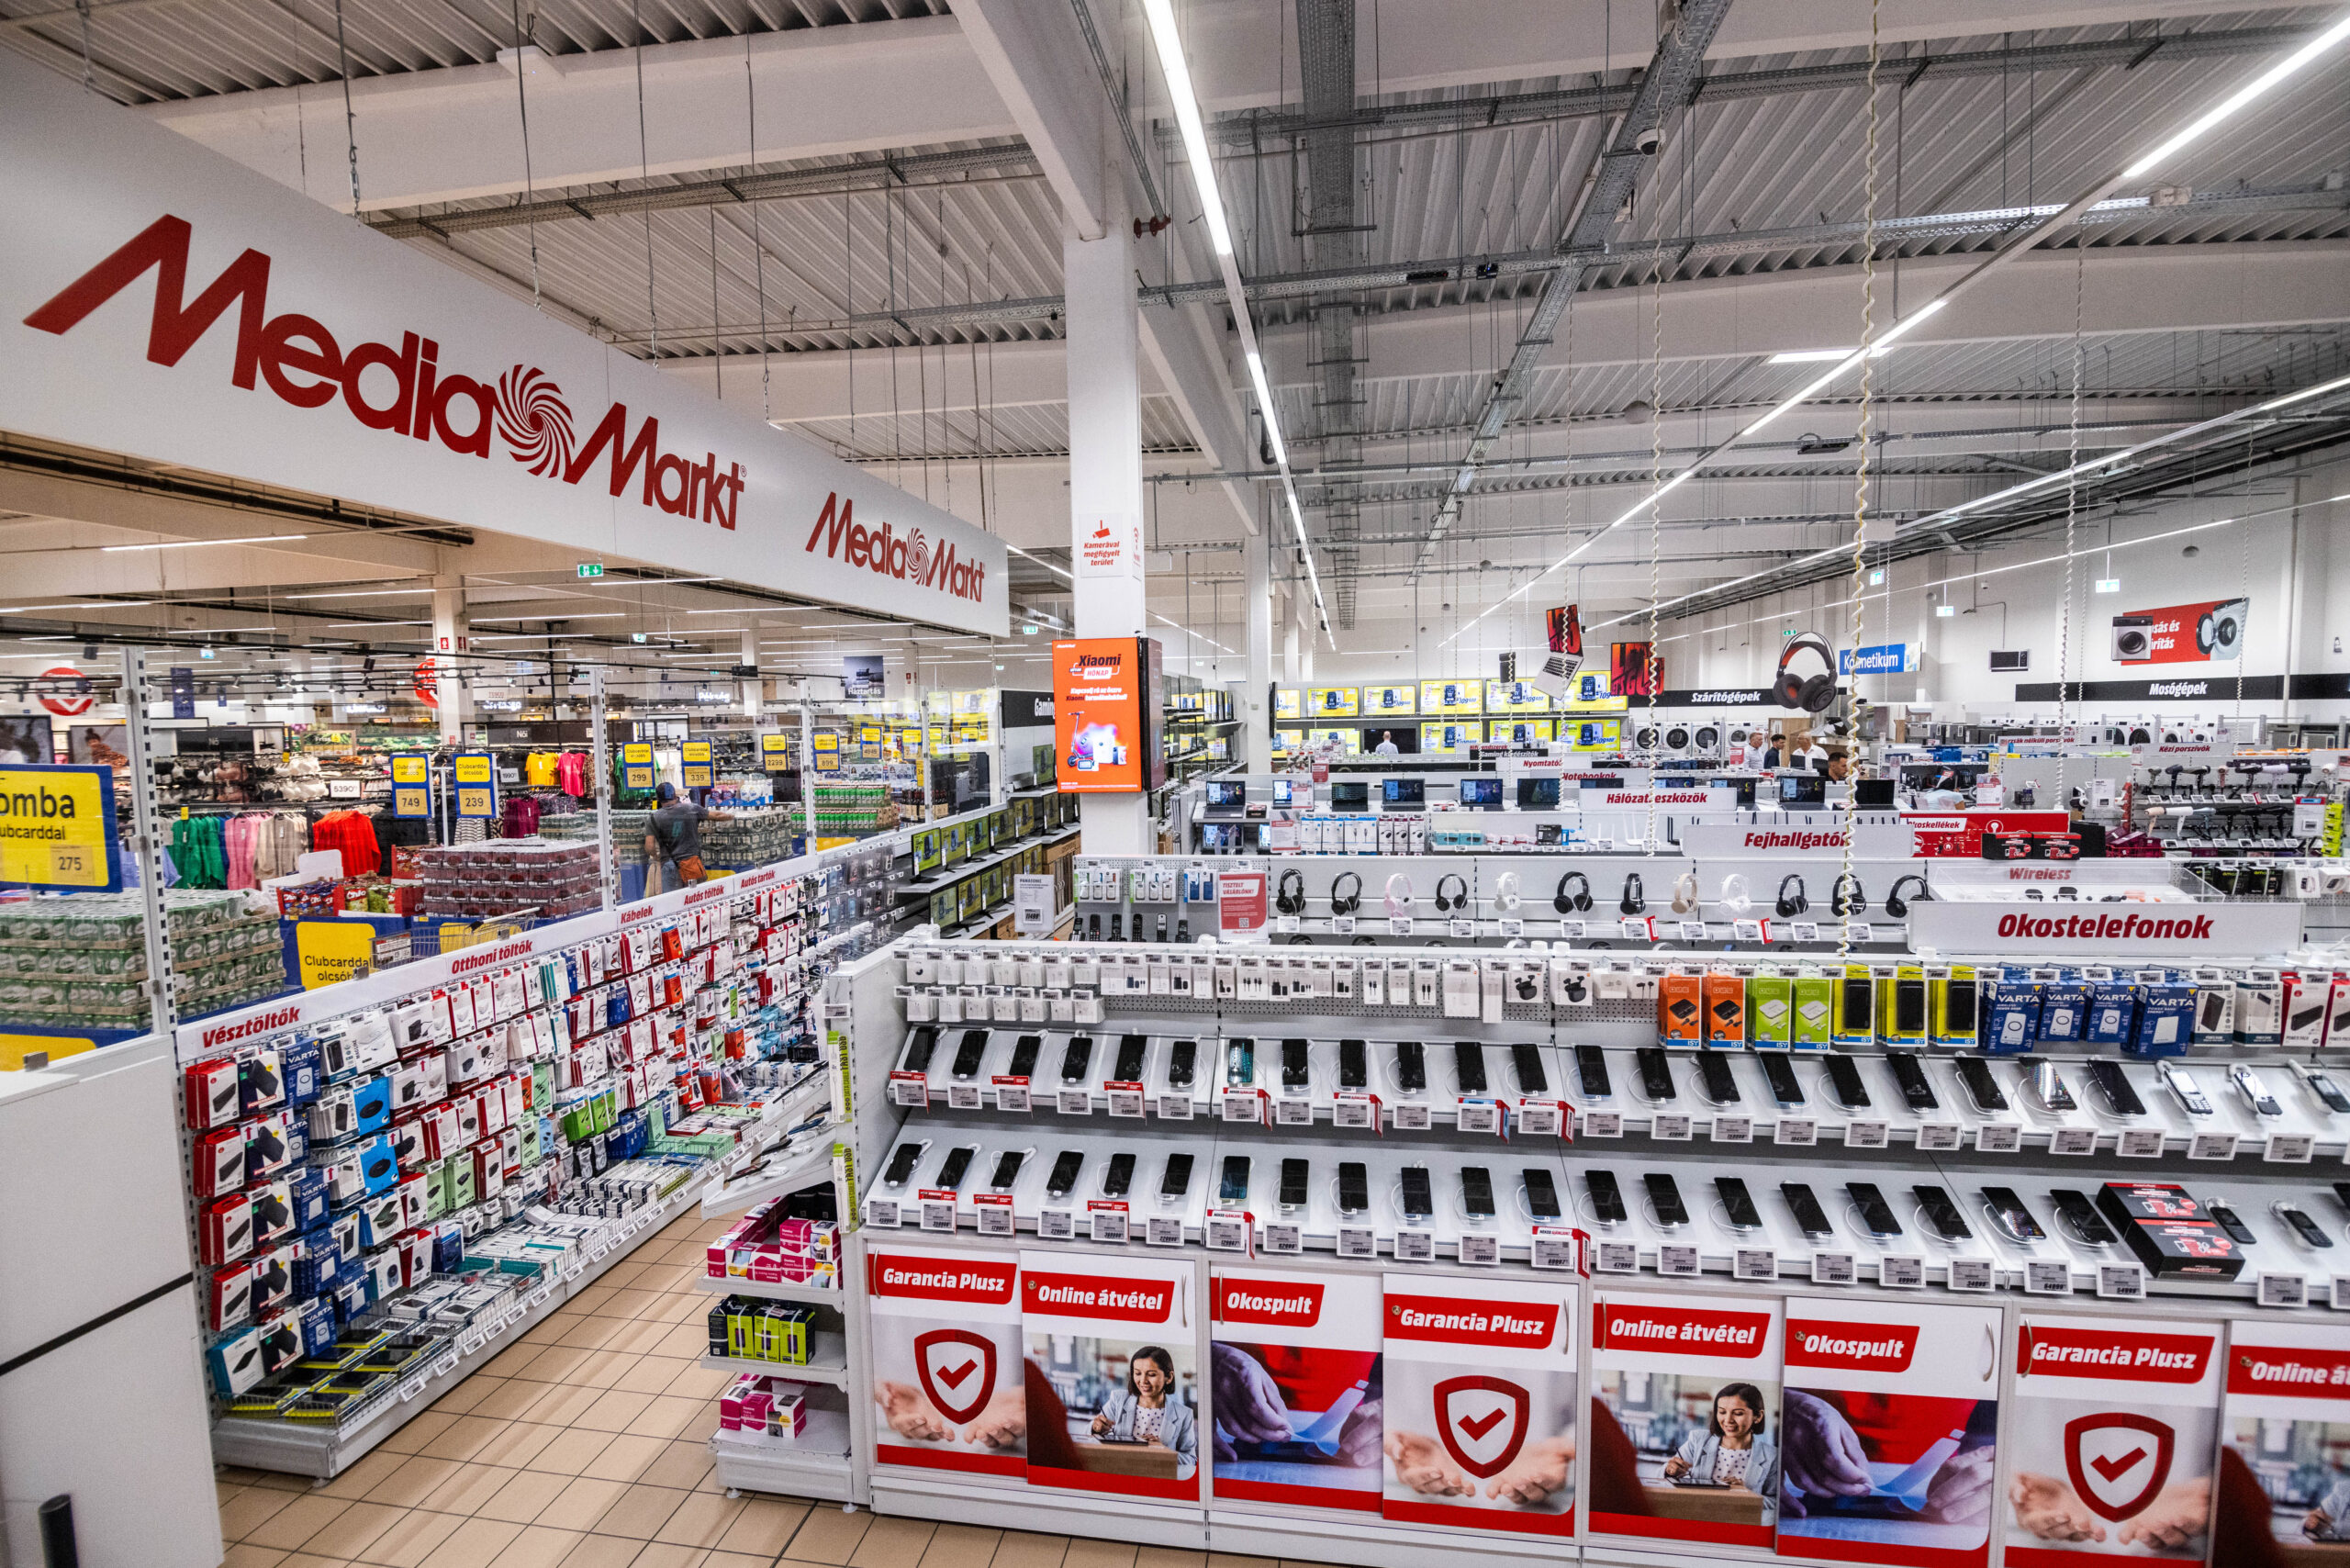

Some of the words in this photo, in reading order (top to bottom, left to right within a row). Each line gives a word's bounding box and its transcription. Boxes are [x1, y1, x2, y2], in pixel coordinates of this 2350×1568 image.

[23, 214, 491, 458] Media
[564, 402, 744, 531] Markt
[805, 492, 907, 580] Media
[925, 538, 985, 602] Markt
[1084, 541, 1120, 549] Kamerával
[1083, 550, 1120, 558] megfigyelt
[2169, 620, 2180, 633] és
[1079, 654, 1121, 666] Xiaomi
[1844, 652, 1898, 670] Kometikum
[1691, 690, 1761, 704] Szárítógépek
[2149, 681, 2207, 697] Mosógépek
[2159, 745, 2176, 753] Kézi
[2177, 745, 2210, 754] porszívók
[632, 774, 647, 782] 299
[401, 797, 420, 807] 749
[465, 797, 484, 807] 239
[1654, 792, 1707, 803] eszközök
[58, 857, 82, 870] 275
[740, 875, 757, 889] Autós
[757, 869, 775, 886] tartók
[2009, 868, 2071, 880] Wireless
[347, 889, 366, 899] Chio
[684, 890, 703, 906] Autós
[704, 884, 724, 901] töltők
[621, 905, 654, 924] Kábelek
[1998, 913, 2214, 940] Okostelefonok
[452, 947, 497, 975] Otthoni
[498, 939, 532, 960] töltők
[1998, 994, 2040, 1002] VARTA
[2149, 998, 2195, 1006] VARTA
[203, 1006, 300, 1048] Vésztöltők
[287, 1049, 319, 1064] VARTA
[285, 1118, 308, 1131] ARTA
[302, 1183, 329, 1197] VARTA
[314, 1241, 341, 1259] VARTA
[883, 1267, 957, 1289] Garancia
[959, 1272, 1005, 1293] Plusz
[1037, 1285, 1095, 1306] Online
[1097, 1289, 1163, 1311] átvétel
[1226, 1292, 1312, 1316] Okospult
[307, 1305, 333, 1323] VARTA
[1401, 1309, 1488, 1331] Garancia
[1490, 1315, 1544, 1336] Plusz
[1611, 1318, 1677, 1339] Online
[1679, 1321, 1757, 1345] átvétel
[1804, 1334, 1905, 1359] Okospult
[2031, 1341, 2132, 1365] Garancia
[2134, 1347, 2197, 1370] Plusz
[2250, 1362, 2328, 1384] Online
